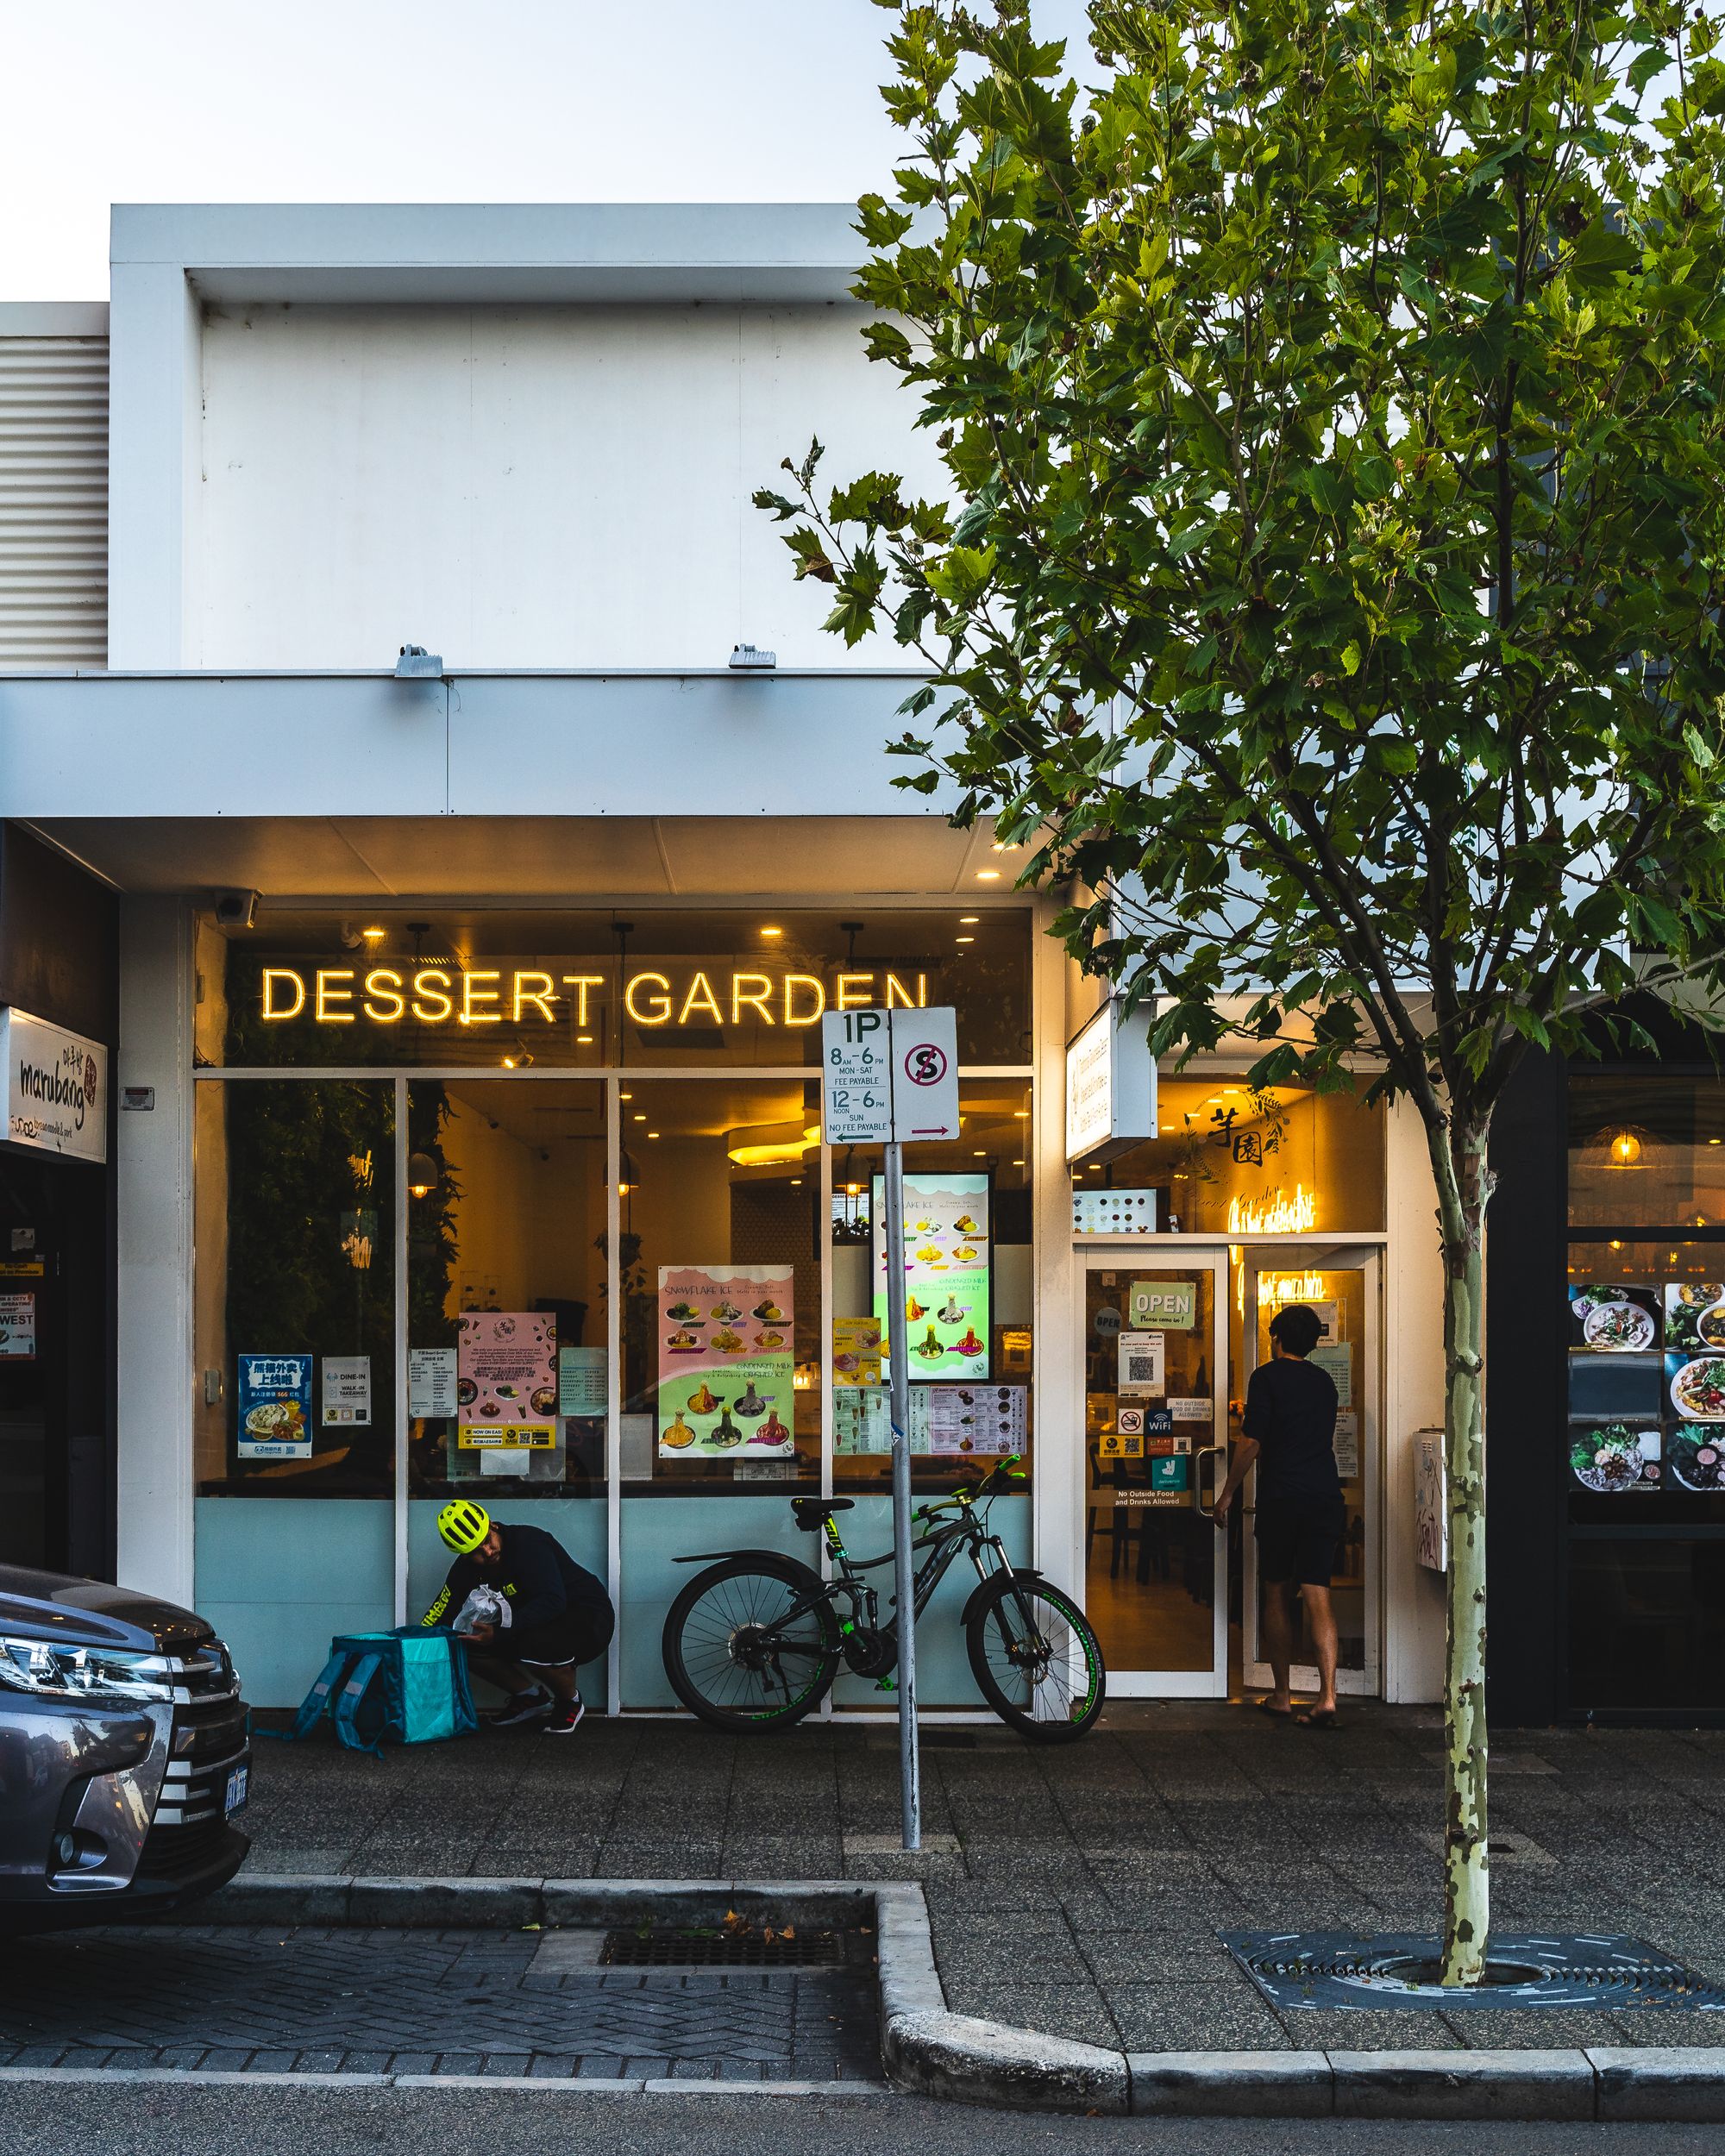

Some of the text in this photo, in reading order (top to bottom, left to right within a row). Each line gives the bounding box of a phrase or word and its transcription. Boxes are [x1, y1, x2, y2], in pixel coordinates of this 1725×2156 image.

[261, 968, 927, 1026] DESSERT GARDEN
[844, 1012, 881, 1044] 1P
[21, 1059, 85, 1131] marubang
[1208, 1107, 1263, 1168] 芋園
[875, 1200, 919, 1209] SNLAKE
[665, 1285, 732, 1296] SNOWFLAKE ICE
[1136, 1294, 1190, 1313] OPEN
[1097, 1316, 1120, 1328] OPEN
[1149, 1421, 1171, 1431] WiFi
